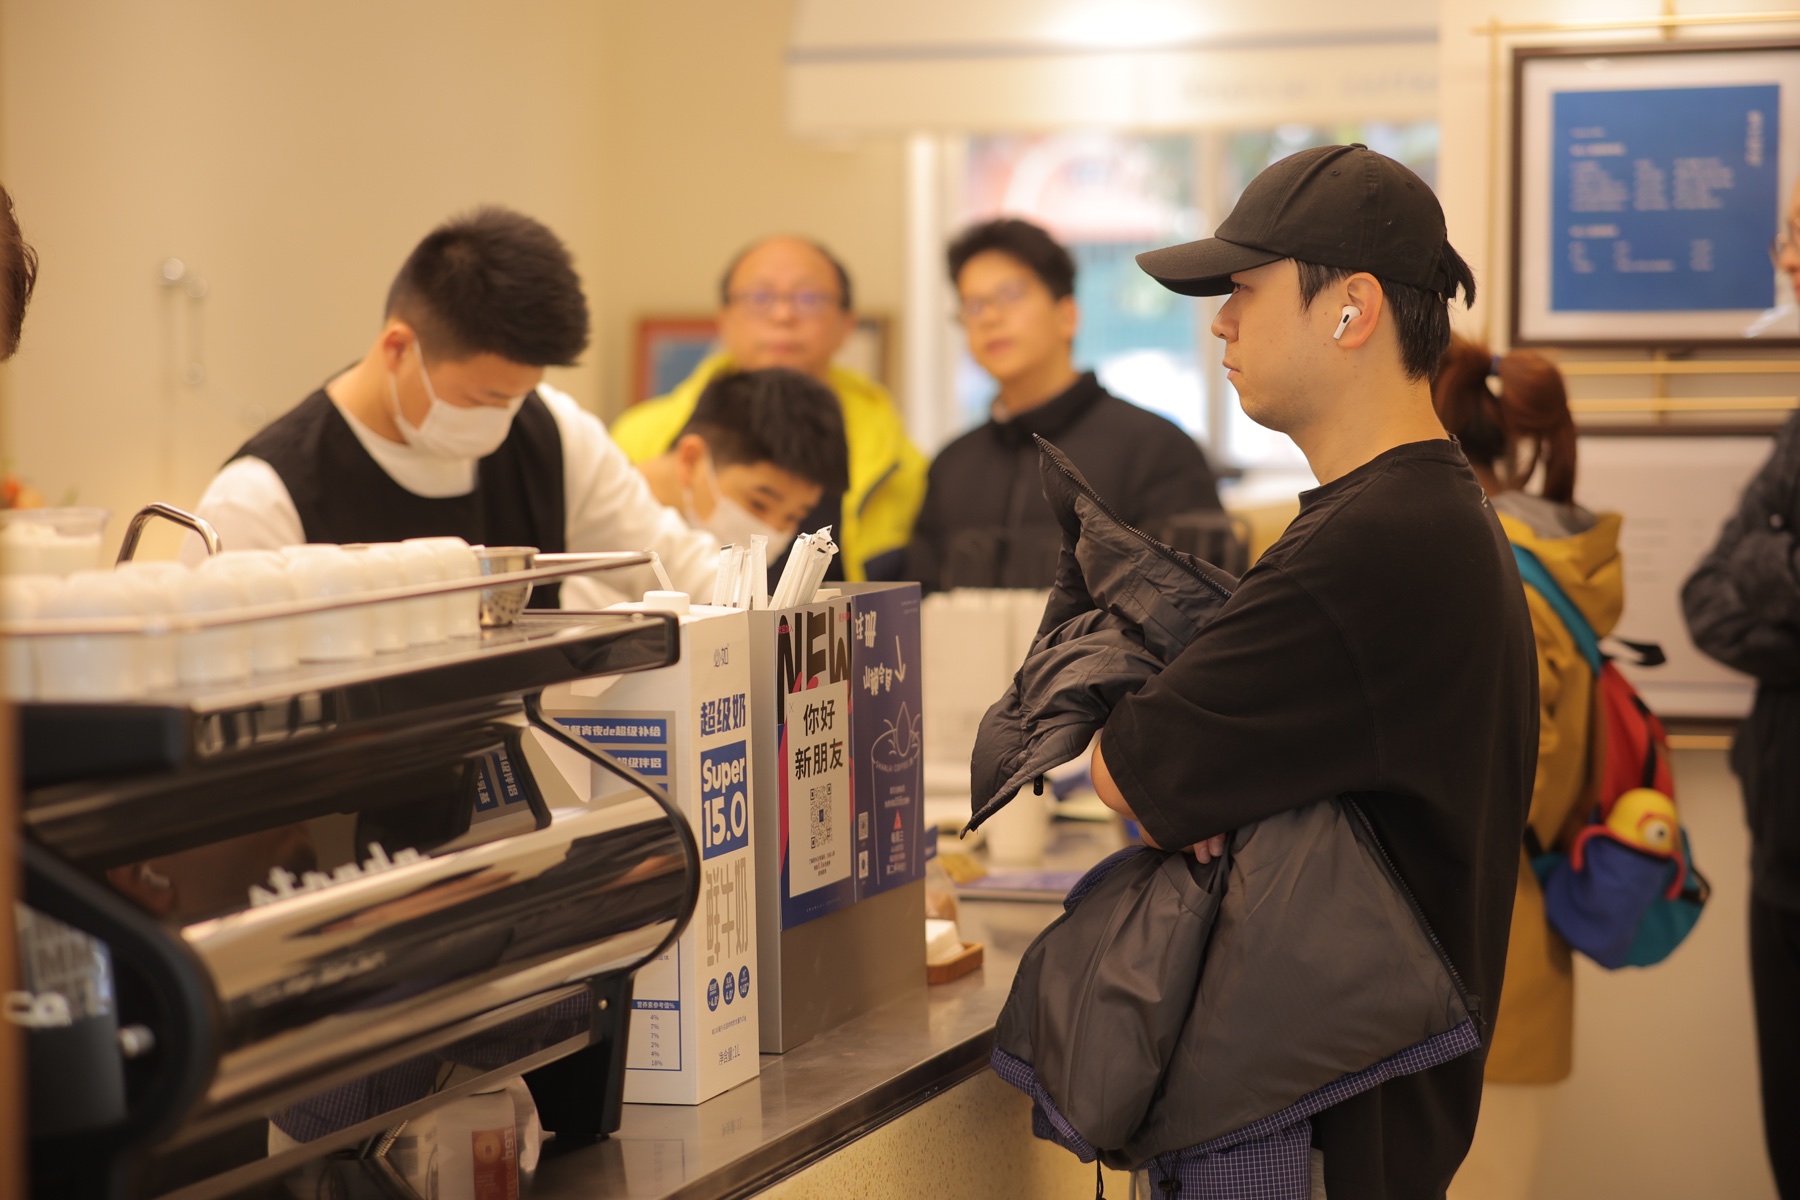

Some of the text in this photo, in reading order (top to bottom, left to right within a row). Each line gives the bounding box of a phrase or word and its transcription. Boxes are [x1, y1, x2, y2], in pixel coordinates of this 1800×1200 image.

[700, 693, 746, 737] 超级奶
[803, 700, 836, 736] 你好
[702, 757, 745, 793] Super
[795, 738, 843, 780] 新朋友
[703, 791, 746, 848] 15.0
